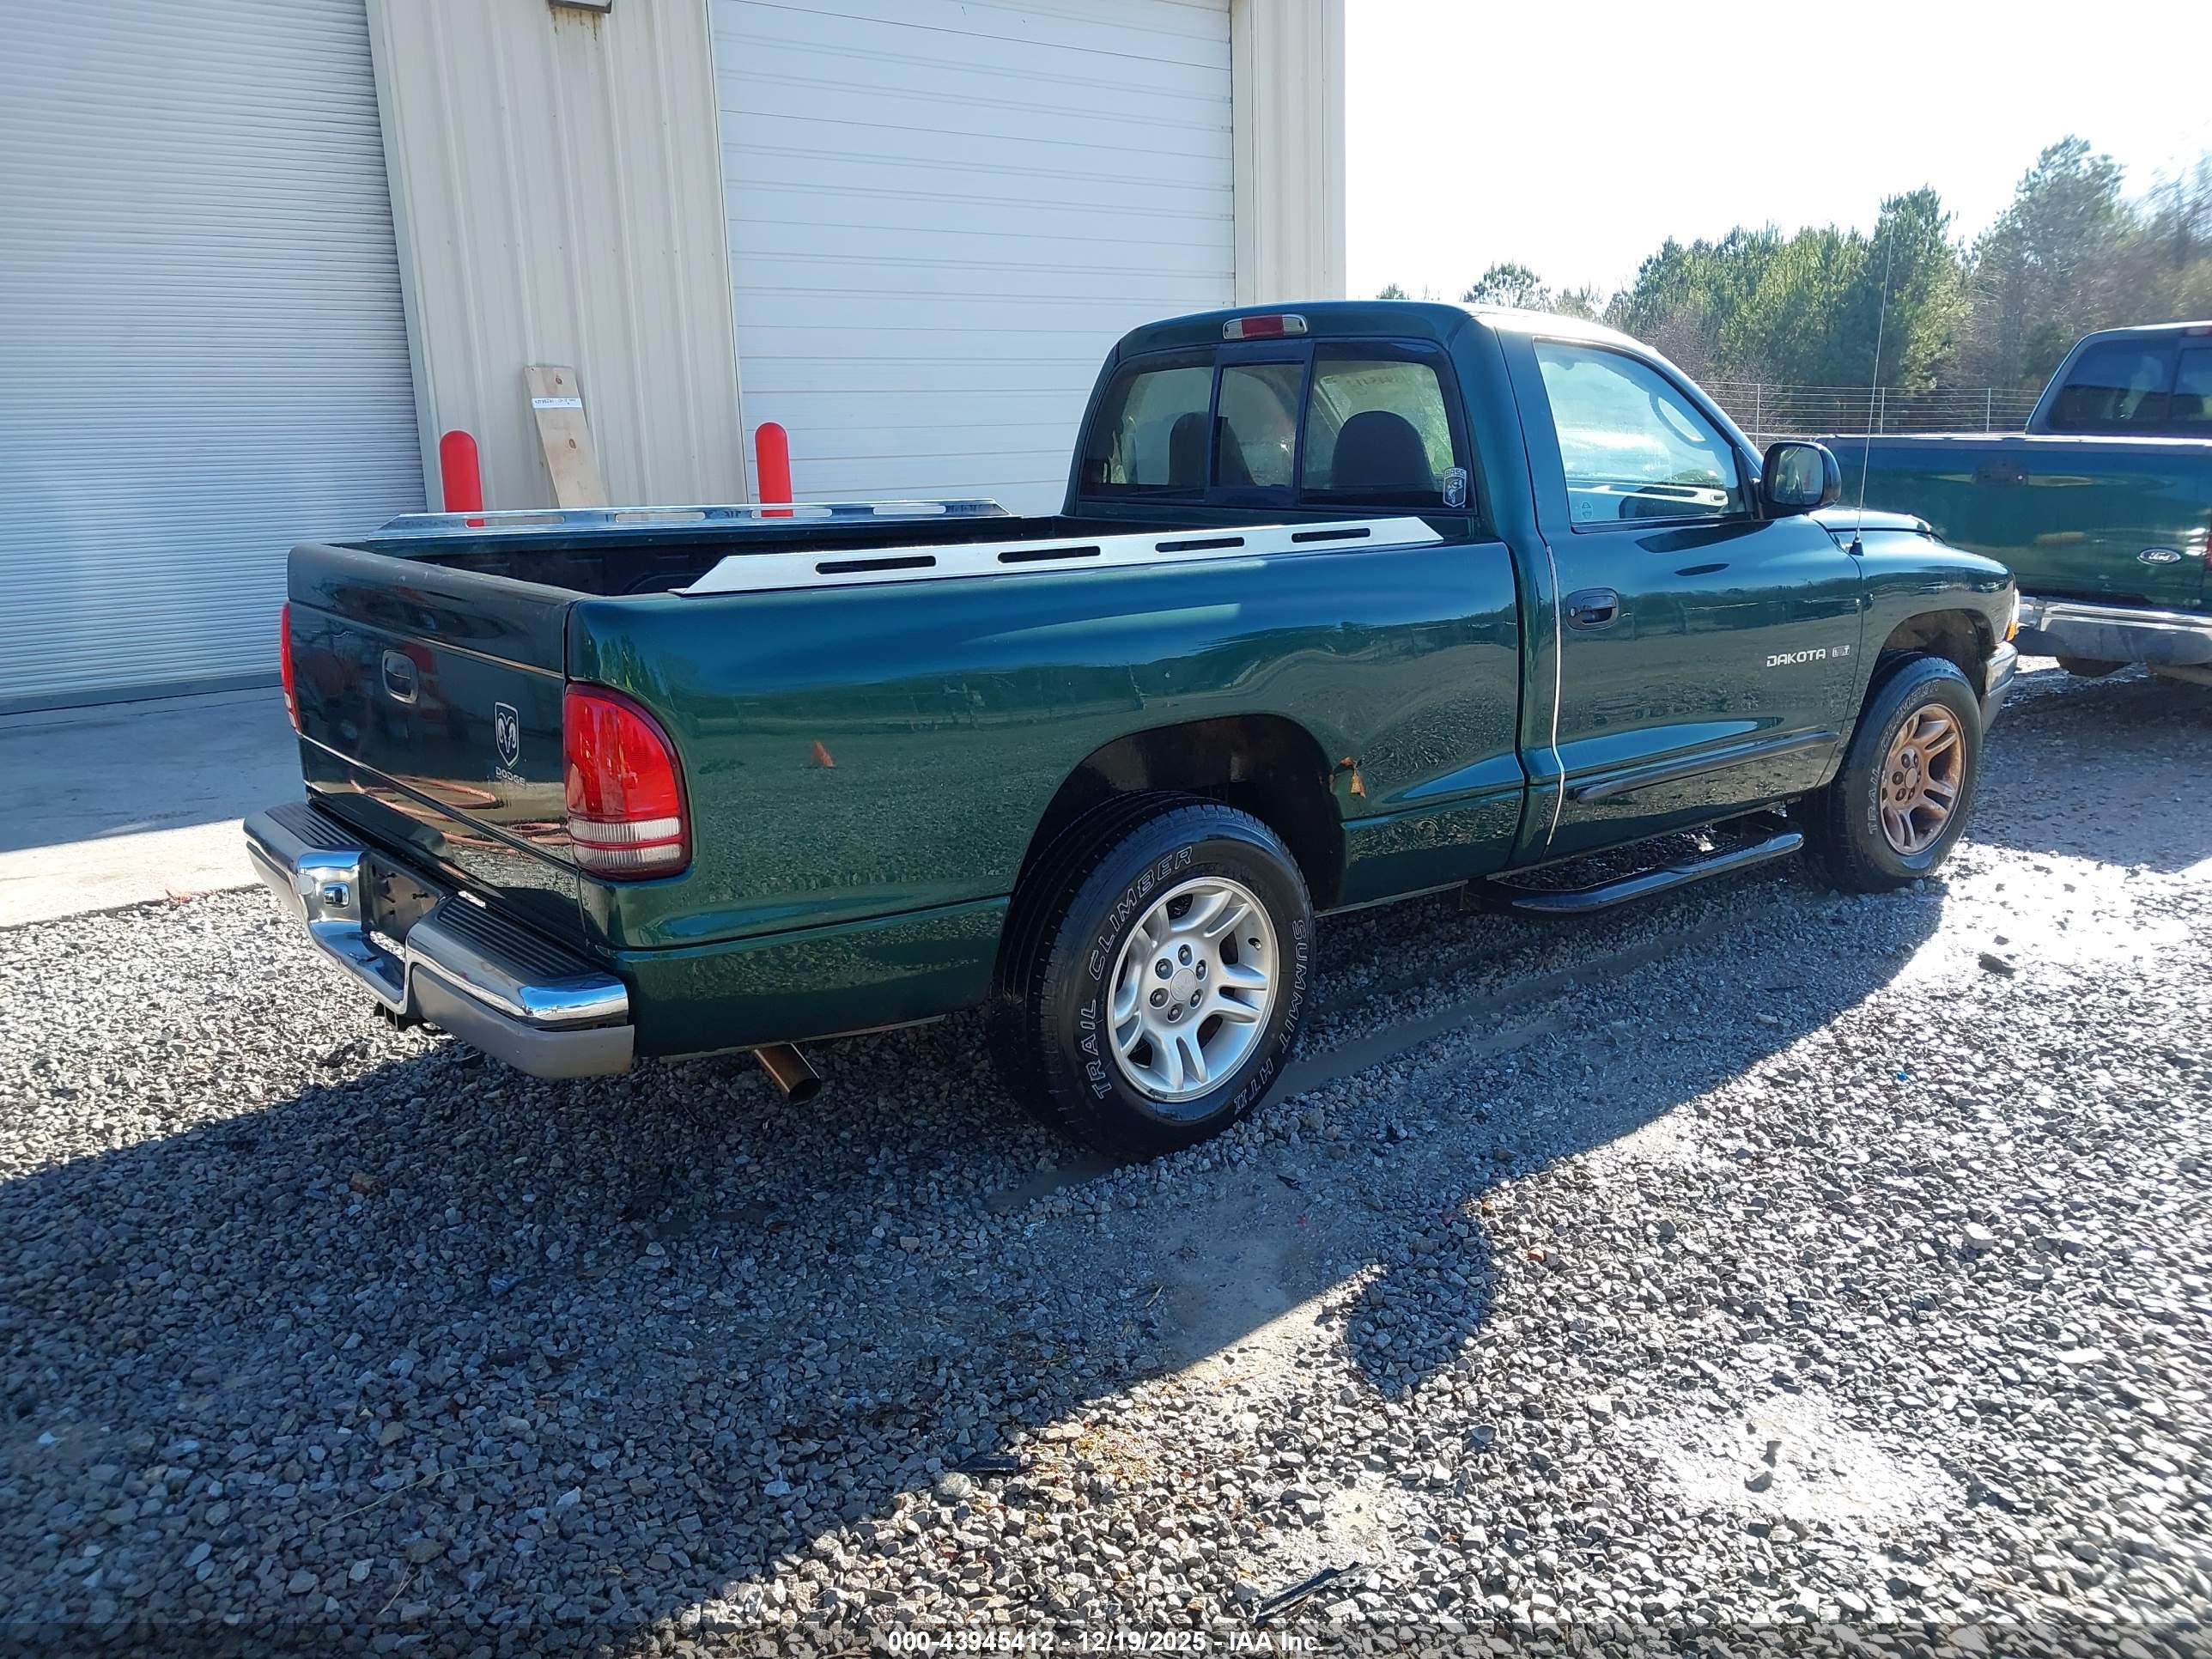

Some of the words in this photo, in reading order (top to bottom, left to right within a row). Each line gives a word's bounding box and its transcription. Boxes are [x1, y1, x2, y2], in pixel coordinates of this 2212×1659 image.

[1766, 648, 1826, 667] DAKOTA
[495, 766, 526, 786] DODGE
[1868, 764, 1881, 836] TRAIL
[1088, 845, 1193, 981] CLIMBER
[1278, 919, 1308, 1054] SUMMIT
[1080, 999, 1113, 1100] TRAIL
